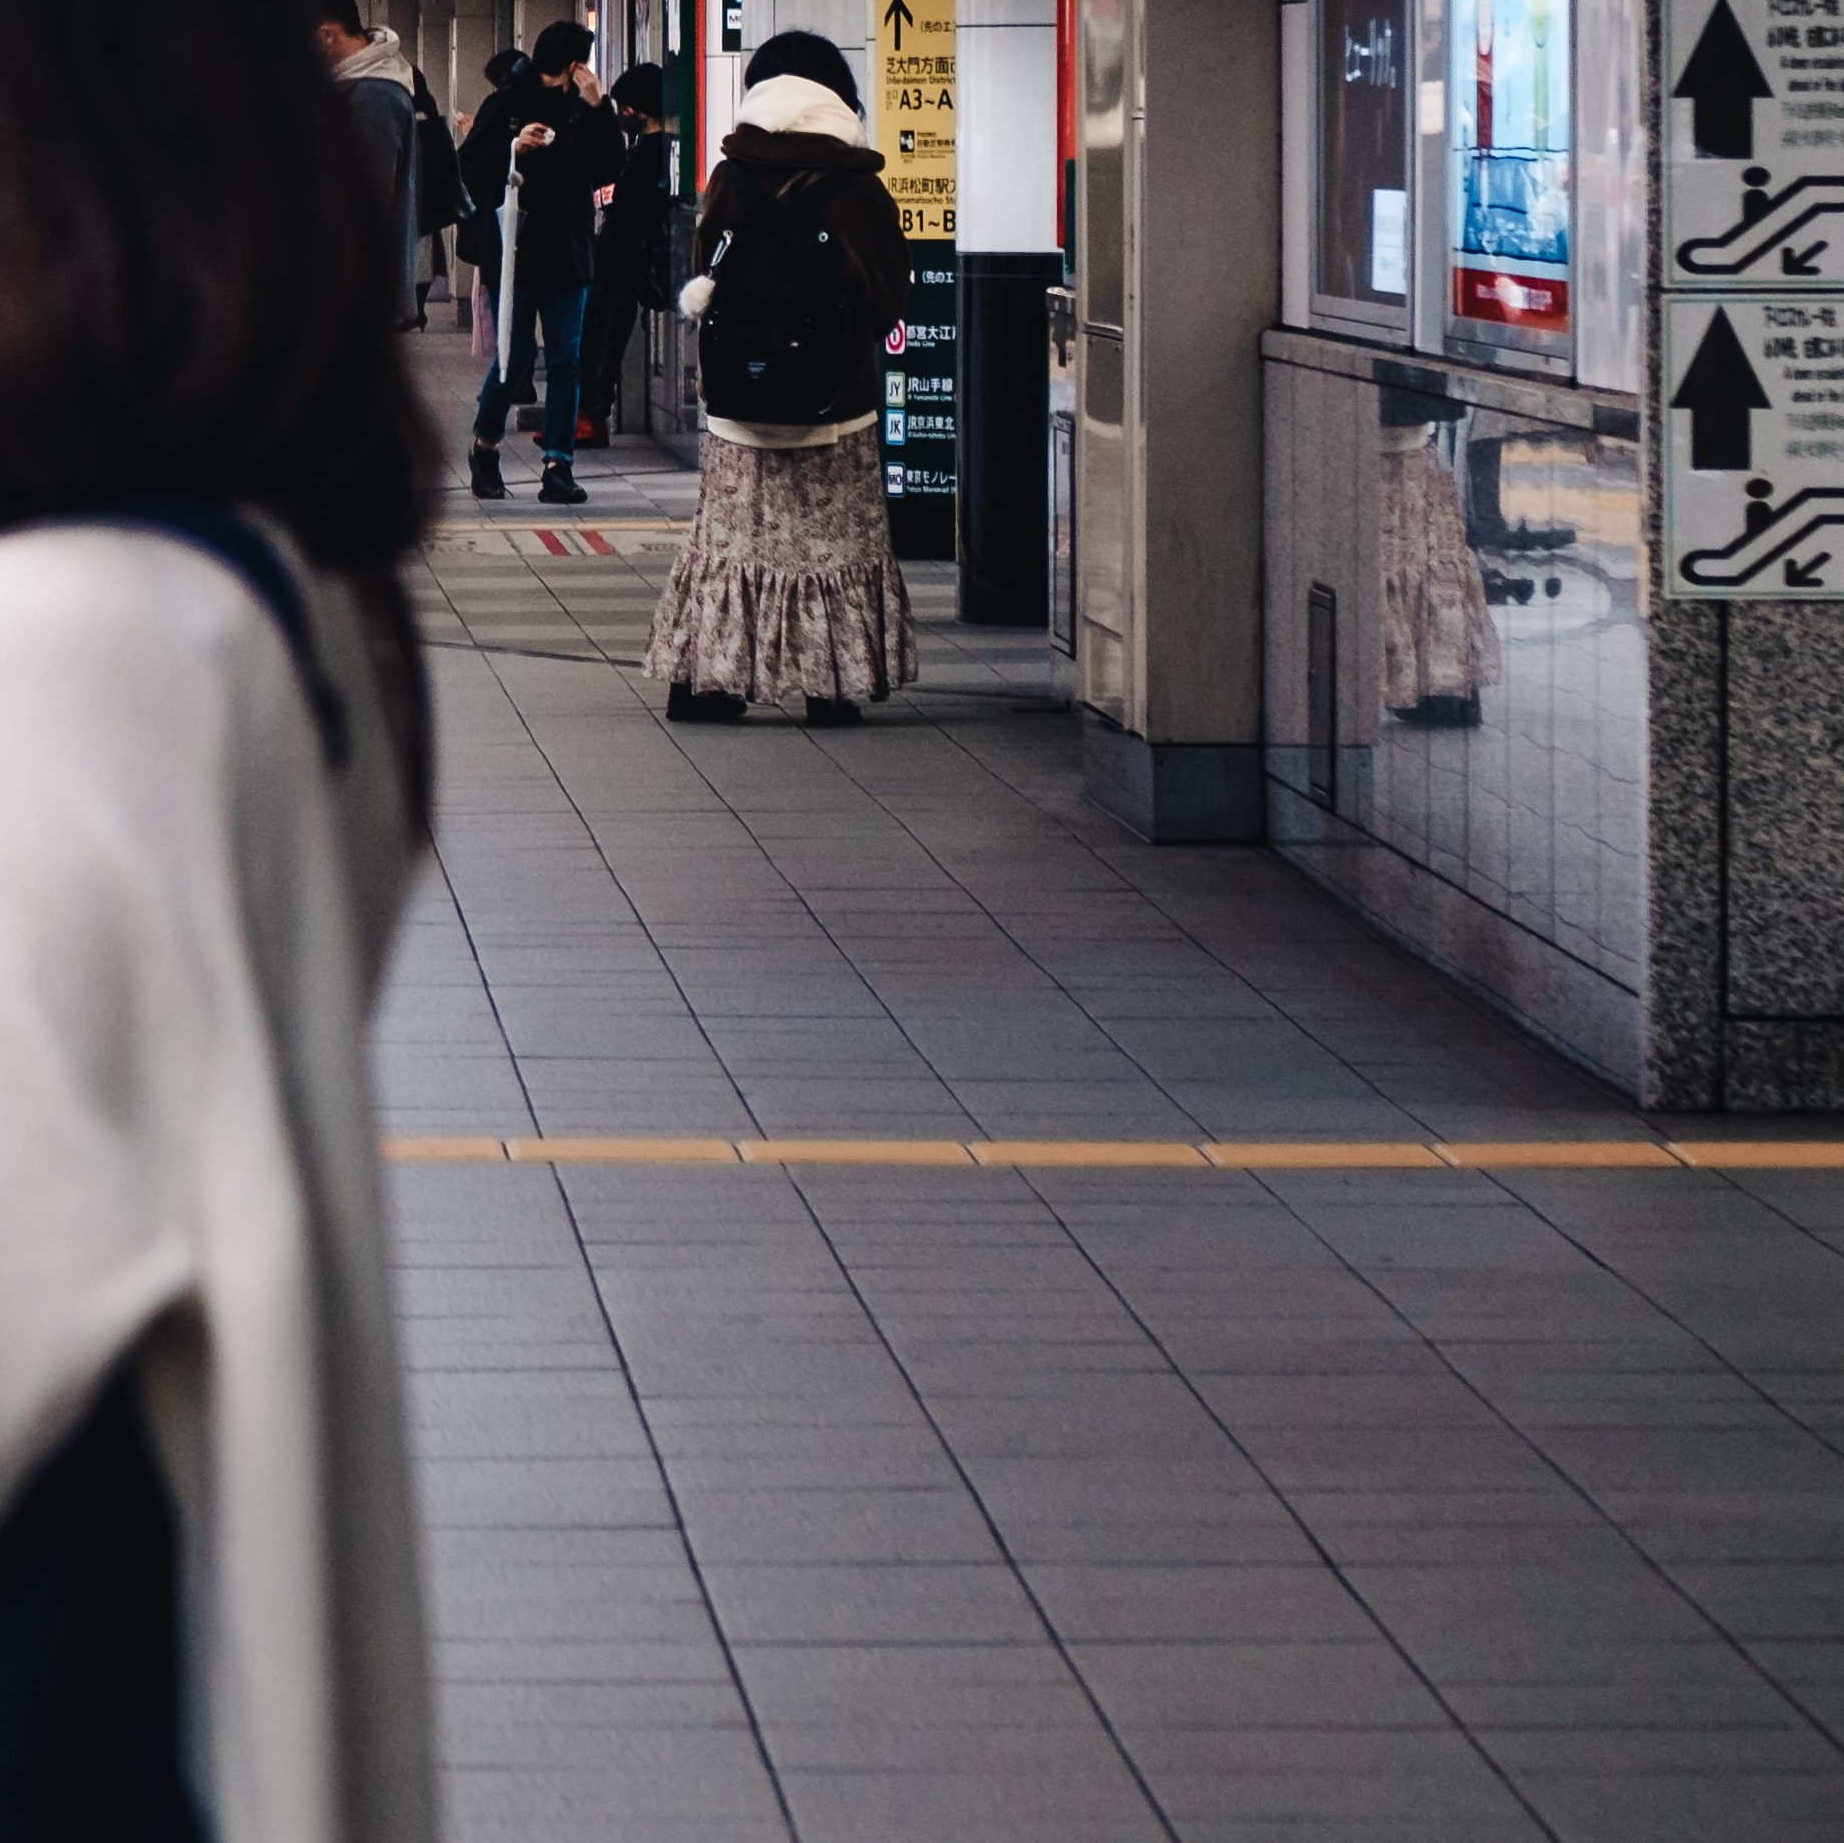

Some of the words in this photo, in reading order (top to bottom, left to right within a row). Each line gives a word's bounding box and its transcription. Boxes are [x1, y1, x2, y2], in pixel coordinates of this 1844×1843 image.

[906, 325, 956, 340] 都営大江
[889, 381, 901, 397] JY
[907, 377, 953, 393] JR山手線
[889, 419, 901, 435] JK
